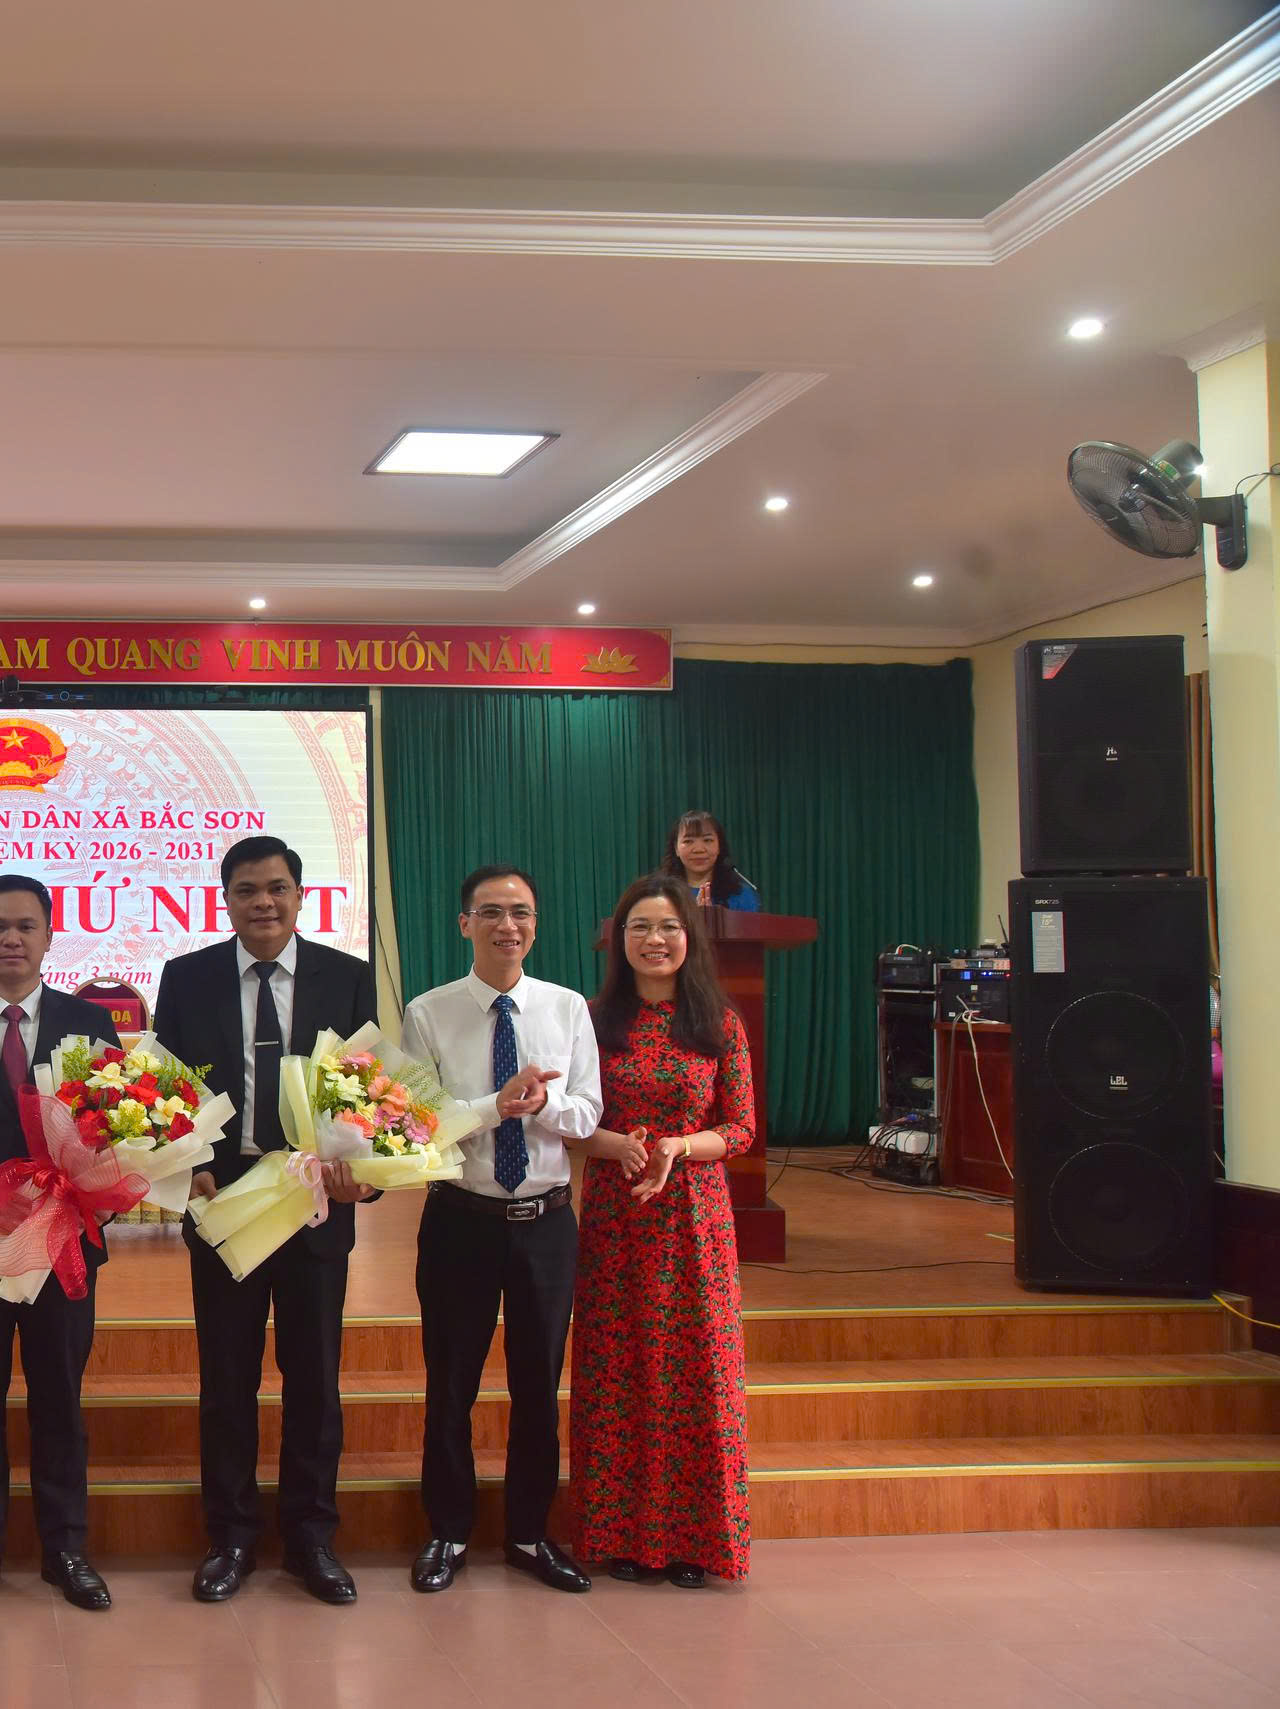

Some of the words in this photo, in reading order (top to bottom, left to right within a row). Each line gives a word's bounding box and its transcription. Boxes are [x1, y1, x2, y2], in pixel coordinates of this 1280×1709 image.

[67, 637, 202, 676] QUANG
[221, 639, 321, 671] VINH
[336, 630, 452, 672] MUÔN
[466, 635, 553, 673] NĂM
[22, 805, 82, 829] DÂN
[92, 805, 130, 829] XÃ
[139, 801, 194, 829] BẮC
[204, 810, 266, 829] SƠN
[43, 836, 81, 860] KỲ
[89, 841, 142, 860] 2026
[165, 841, 215, 860] 2031
